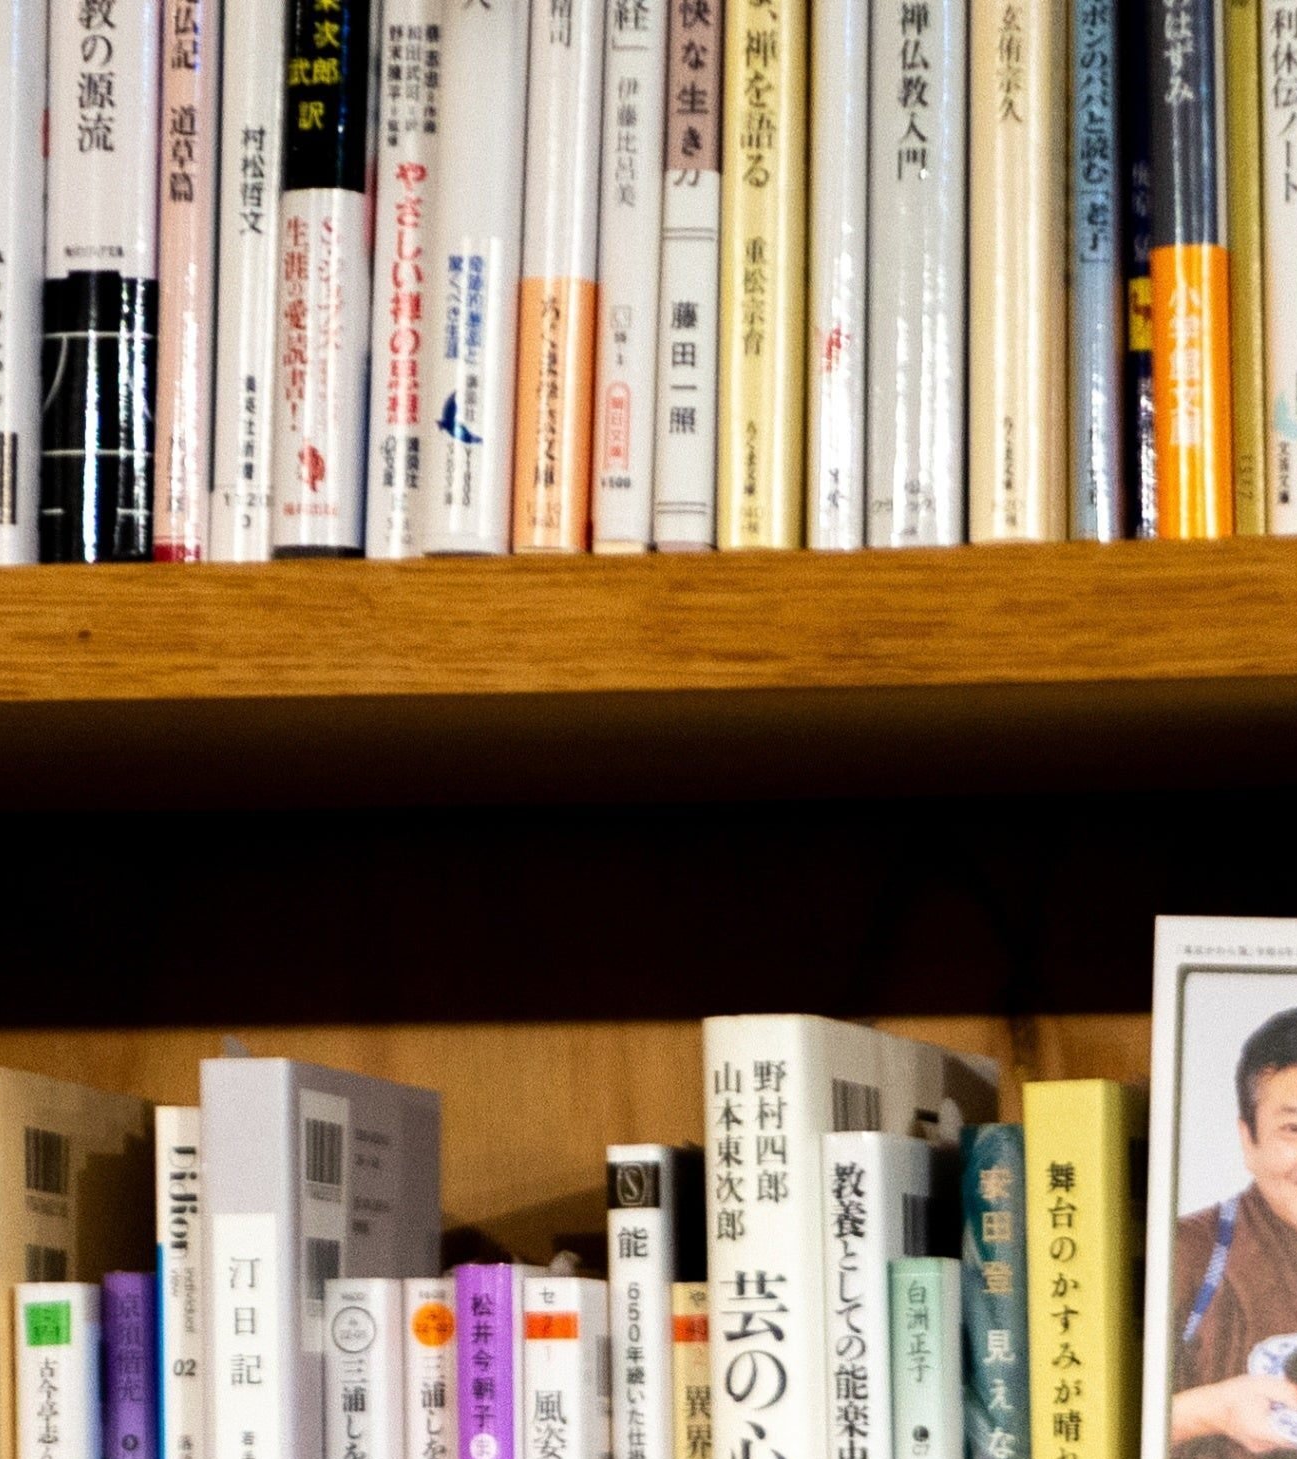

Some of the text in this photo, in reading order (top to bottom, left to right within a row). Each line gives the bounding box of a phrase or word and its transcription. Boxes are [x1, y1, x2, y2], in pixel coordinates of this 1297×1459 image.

[668, 300, 699, 435] 藤田一照
[713, 1062, 745, 1243] 山本東次郎
[753, 1059, 791, 1205] 野村四郎
[618, 1225, 651, 1259] 能
[172, 1358, 196, 1377] 02
[228, 1255, 264, 1388] 汀日記
[470, 1296, 496, 1430] 松井今朝子
[906, 1280, 932, 1384] 白洲正子
